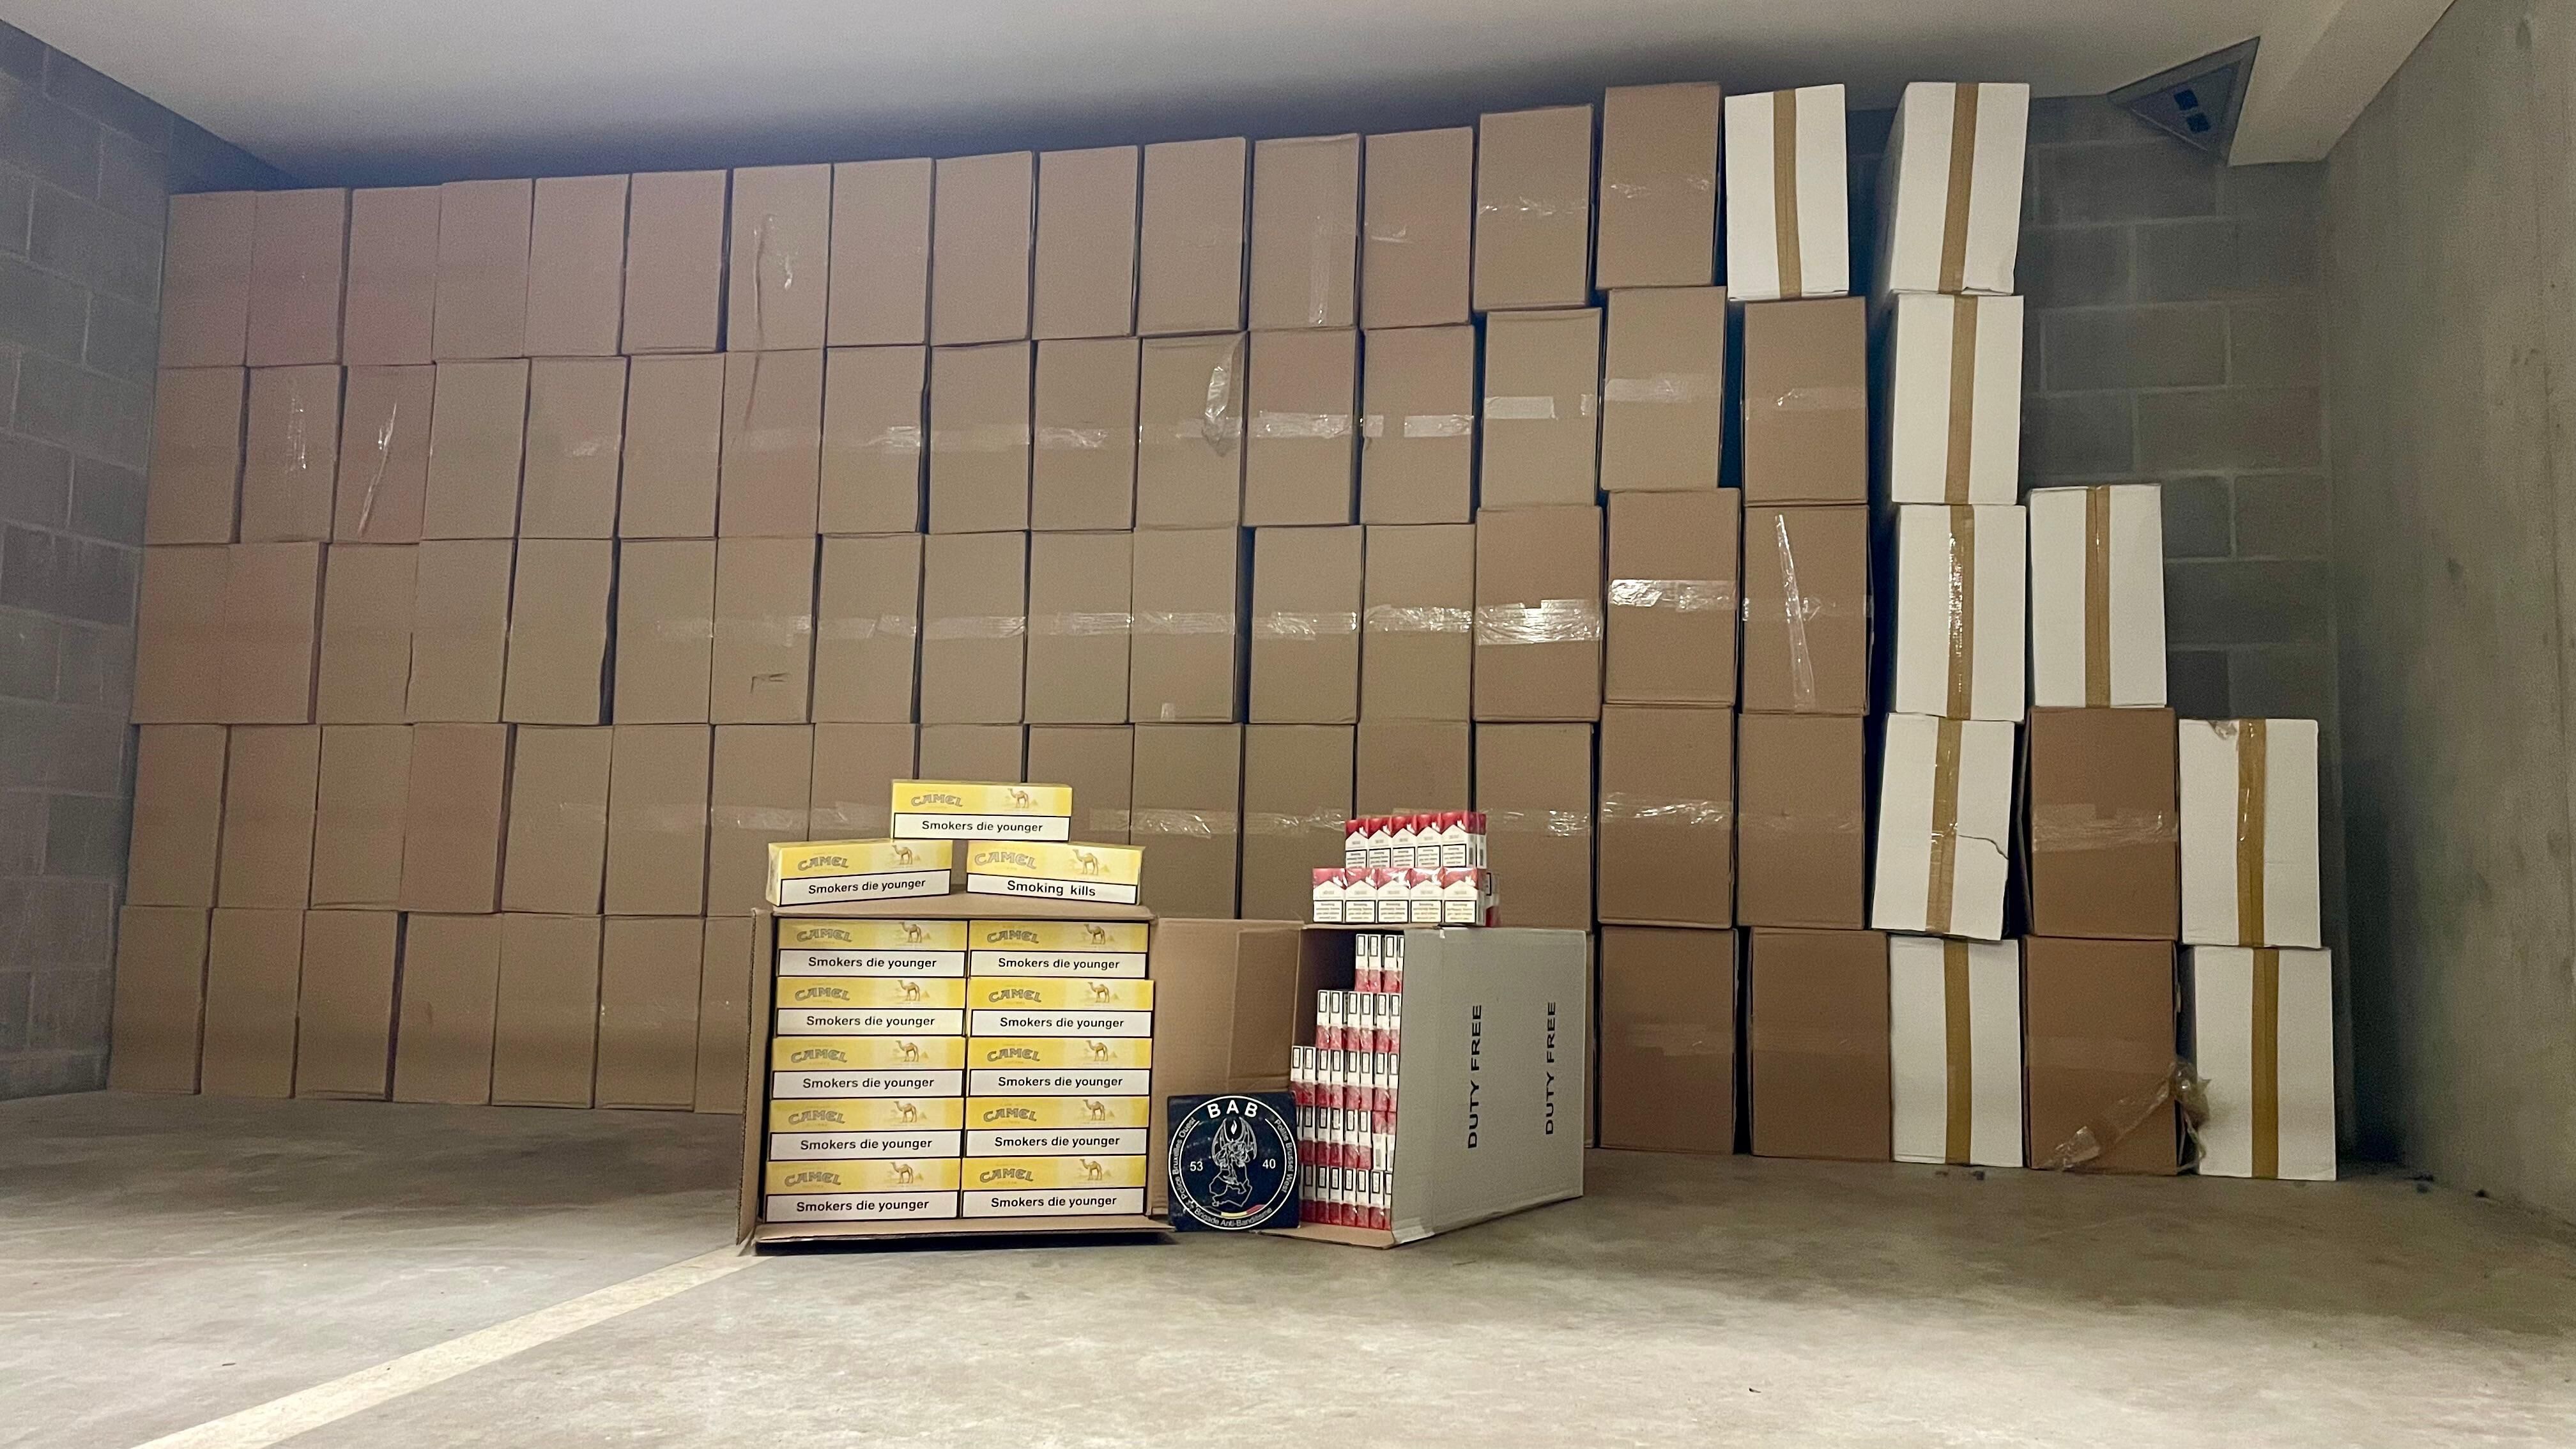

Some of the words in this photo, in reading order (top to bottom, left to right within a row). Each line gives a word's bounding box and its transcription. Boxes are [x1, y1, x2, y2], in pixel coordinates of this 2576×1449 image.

[911, 794, 963, 807] CAMEL
[922, 820, 973, 831] Smokers
[976, 822, 993, 831] die
[997, 824, 1043, 834] younger
[798, 856, 849, 871] CAMEL
[974, 852, 1037, 870] CAMEL
[808, 883, 859, 894] Smokers
[862, 881, 879, 891] die
[881, 880, 926, 892] younger
[1007, 880, 1064, 896] Smoking
[1070, 884, 1096, 896] kills
[797, 928, 852, 942] CAMEL
[987, 930, 1039, 944] CAMEL
[808, 956, 862, 967] Smokers
[866, 958, 885, 967] die
[887, 960, 937, 970] younger
[998, 958, 1049, 968] Smokers
[1053, 958, 1070, 969] die
[1073, 961, 1120, 971] younger
[795, 987, 850, 1001] CAMEL
[988, 989, 1041, 1003] CAMEL
[806, 1015, 861, 1026] Smokers
[864, 1016, 883, 1026] die
[886, 1018, 935, 1028] younger
[1000, 1016, 1052, 1027] Smokers
[1056, 1017, 1074, 1027] die
[1077, 1020, 1124, 1030] younger
[1471, 1005, 1482, 1071] FREE
[1547, 1002, 1556, 1063] FREE
[791, 1049, 848, 1063] CAMEL
[987, 1048, 1040, 1062] CAMEL
[802, 1078, 859, 1089] Smokers
[862, 1077, 881, 1088] die
[884, 1079, 935, 1090] younger
[998, 1077, 1051, 1087] Smokers
[1054, 1077, 1072, 1086] die
[1075, 1078, 1123, 1089] younger
[1545, 1072, 1554, 1135] DUTY
[788, 1110, 845, 1125] CAMEL
[983, 1108, 1037, 1122] CAMEL
[1468, 1080, 1480, 1148] DUTY
[1179, 1117, 1196, 1137] Ouest
[800, 1139, 856, 1151] Smokers
[860, 1138, 879, 1149] die
[882, 1140, 933, 1151] younger
[994, 1136, 1048, 1147] Smokers
[1051, 1136, 1070, 1146] die
[1072, 1138, 1121, 1148] younger
[1262, 1158, 1276, 1169] 40
[1285, 1142, 1294, 1172] Brussel
[1190, 1161, 1204, 1172] 53
[785, 1172, 841, 1187] CAMEL
[979, 1168, 1034, 1183] CAMEL
[1176, 1176, 1188, 1200] Police
[1282, 1174, 1292, 1193] West
[796, 1200, 852, 1213] Smokers
[856, 1200, 875, 1211] die
[878, 1201, 930, 1213] younger
[991, 1197, 1045, 1208] Smokers
[1048, 1196, 1066, 1206] die
[1069, 1197, 1117, 1209] younger
[1194, 1208, 1219, 1225] Brigade
